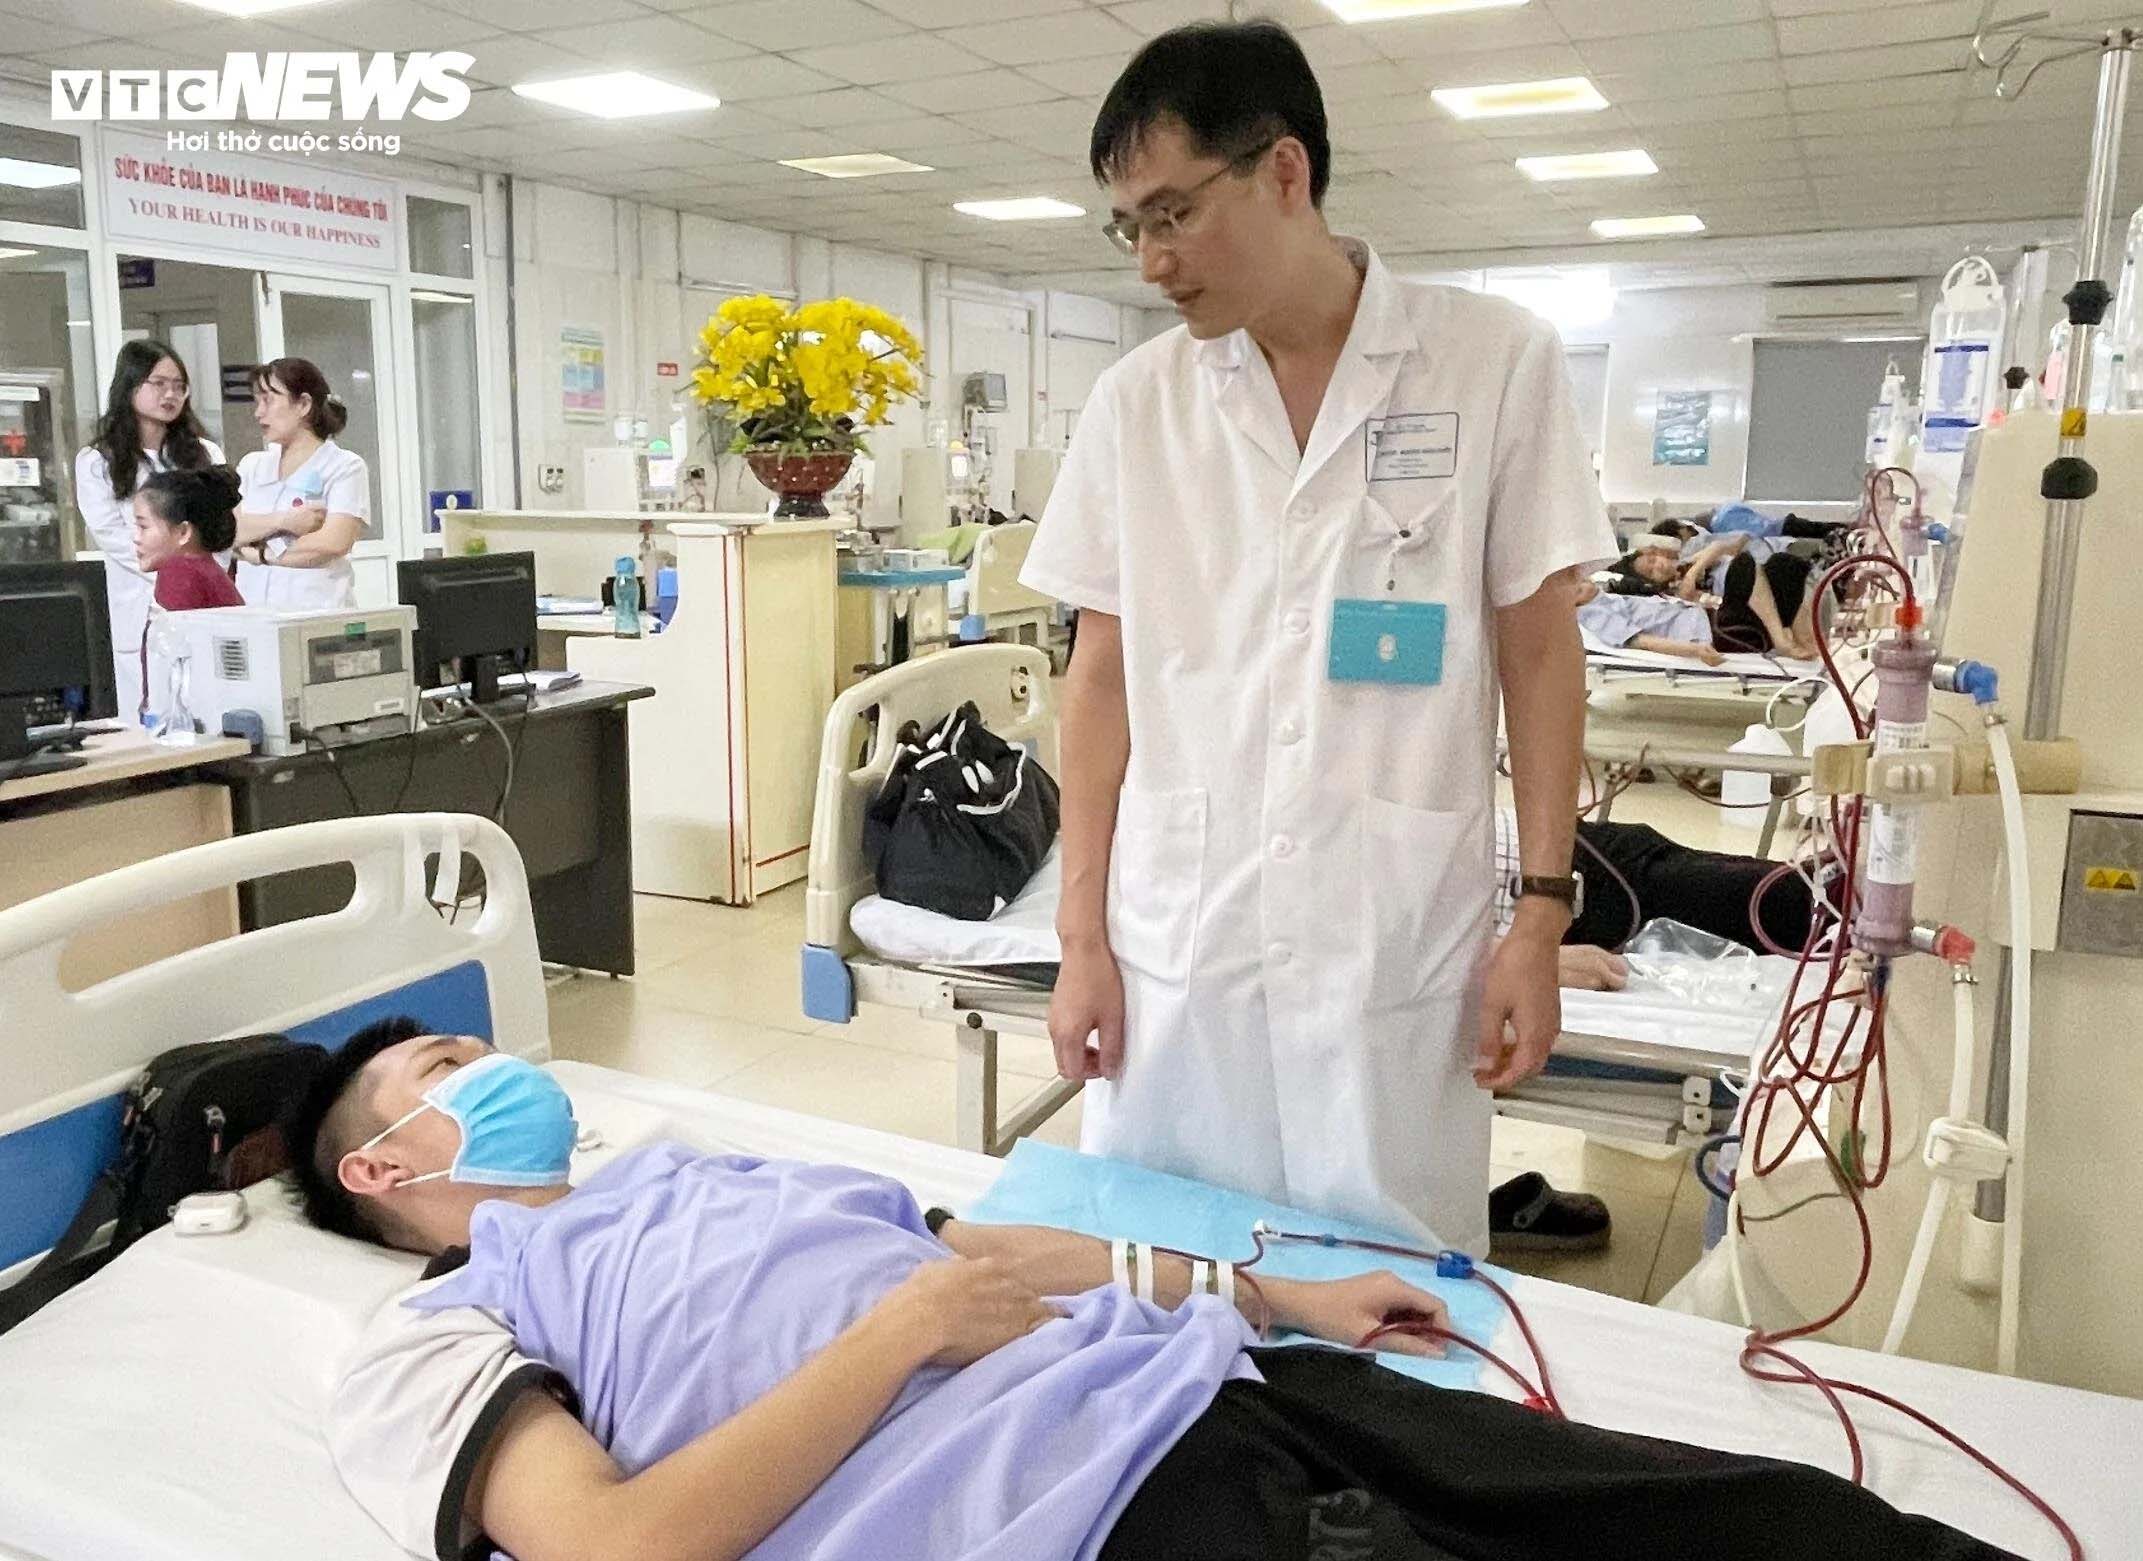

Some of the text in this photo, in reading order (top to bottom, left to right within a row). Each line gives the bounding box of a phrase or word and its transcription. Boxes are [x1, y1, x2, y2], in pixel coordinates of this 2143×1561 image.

[128, 197, 380, 249] YOUR HEALTH IS OUR HAPPINESS
